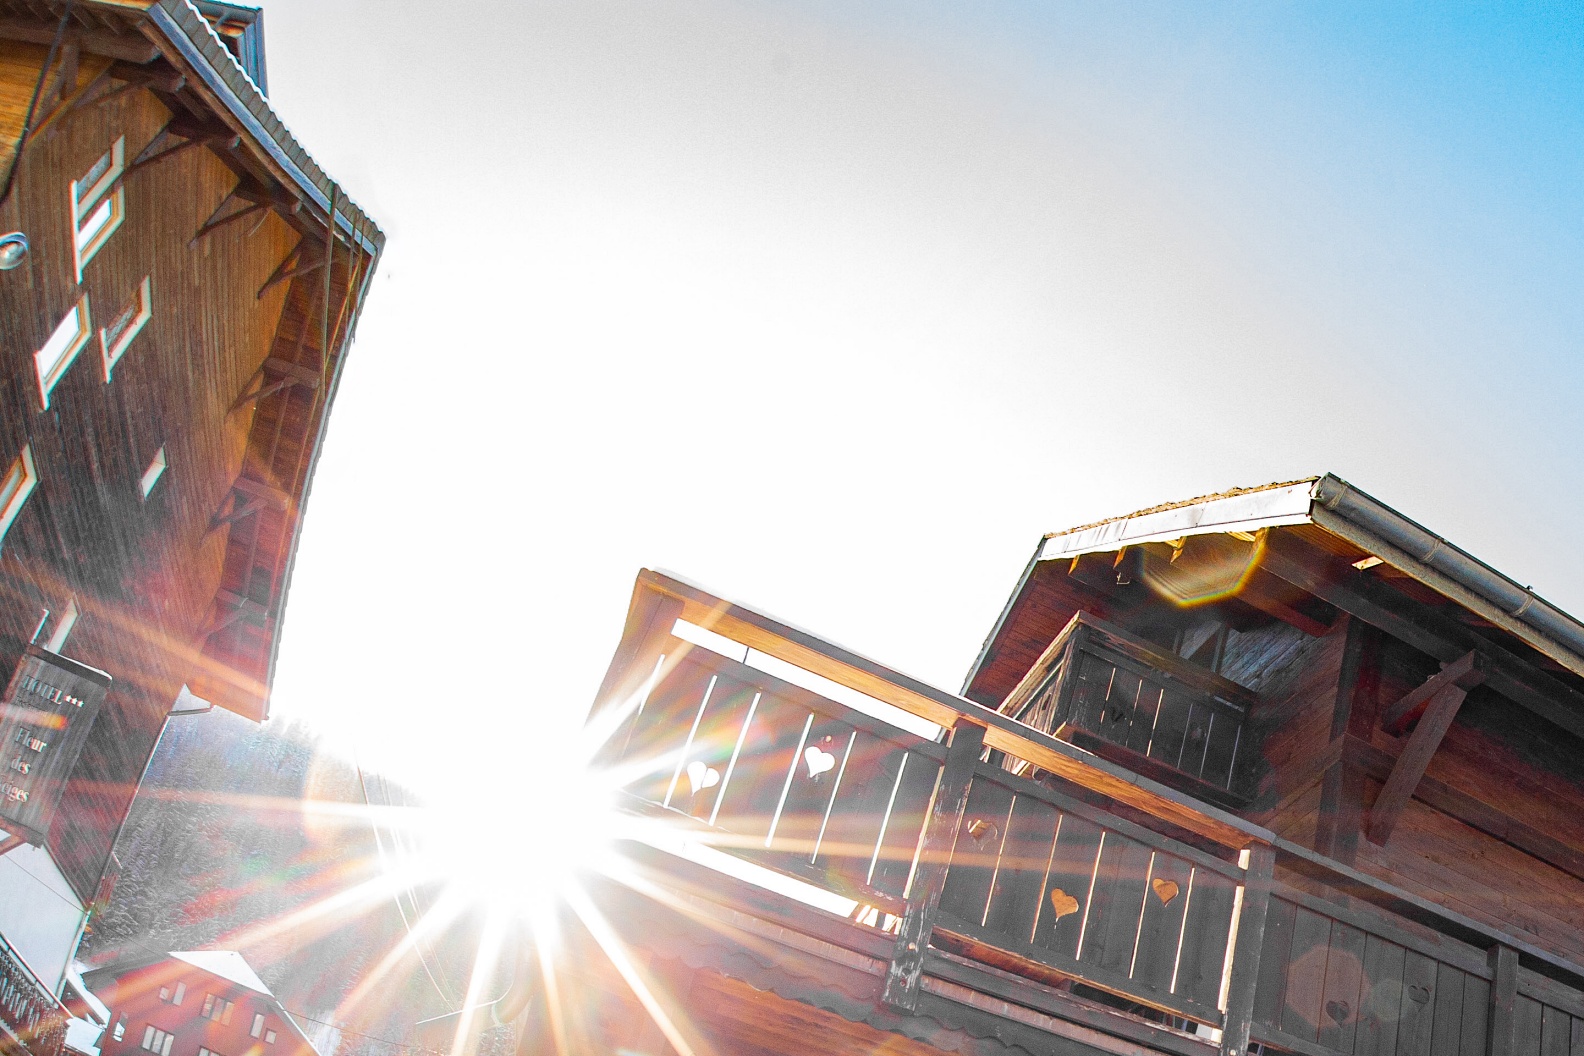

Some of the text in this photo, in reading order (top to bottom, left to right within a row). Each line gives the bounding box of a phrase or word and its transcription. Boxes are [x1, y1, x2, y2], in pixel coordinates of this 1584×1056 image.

[22, 675, 63, 705] HOTEL
[15, 727, 47, 753] Fleur
[11, 754, 31, 775] des
[0, 777, 30, 803] eiges
